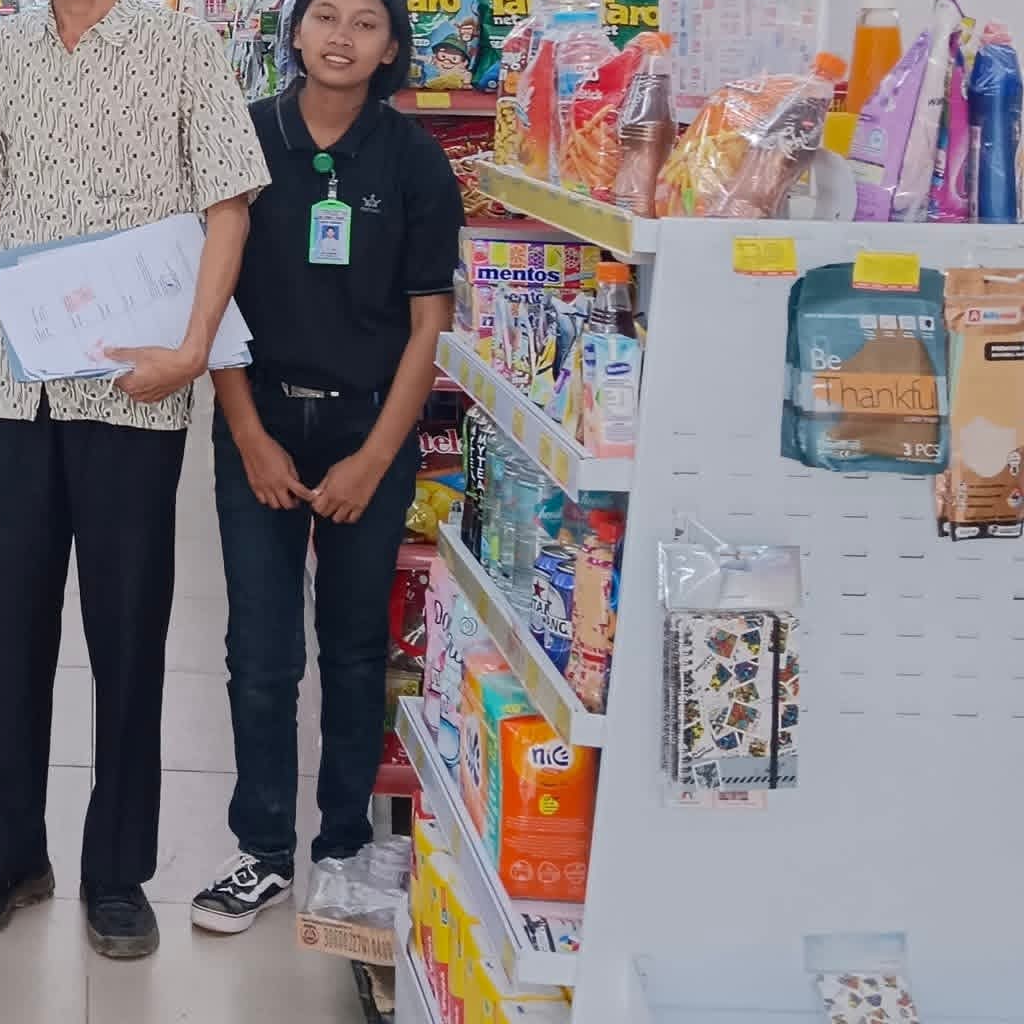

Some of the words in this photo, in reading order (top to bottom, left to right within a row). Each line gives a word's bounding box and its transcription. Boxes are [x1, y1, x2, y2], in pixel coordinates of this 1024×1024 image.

[477, 267, 561, 283] mentos
[810, 346, 842, 371] Be
[903, 443, 912, 457] 3
[916, 443, 942, 458] PCS
